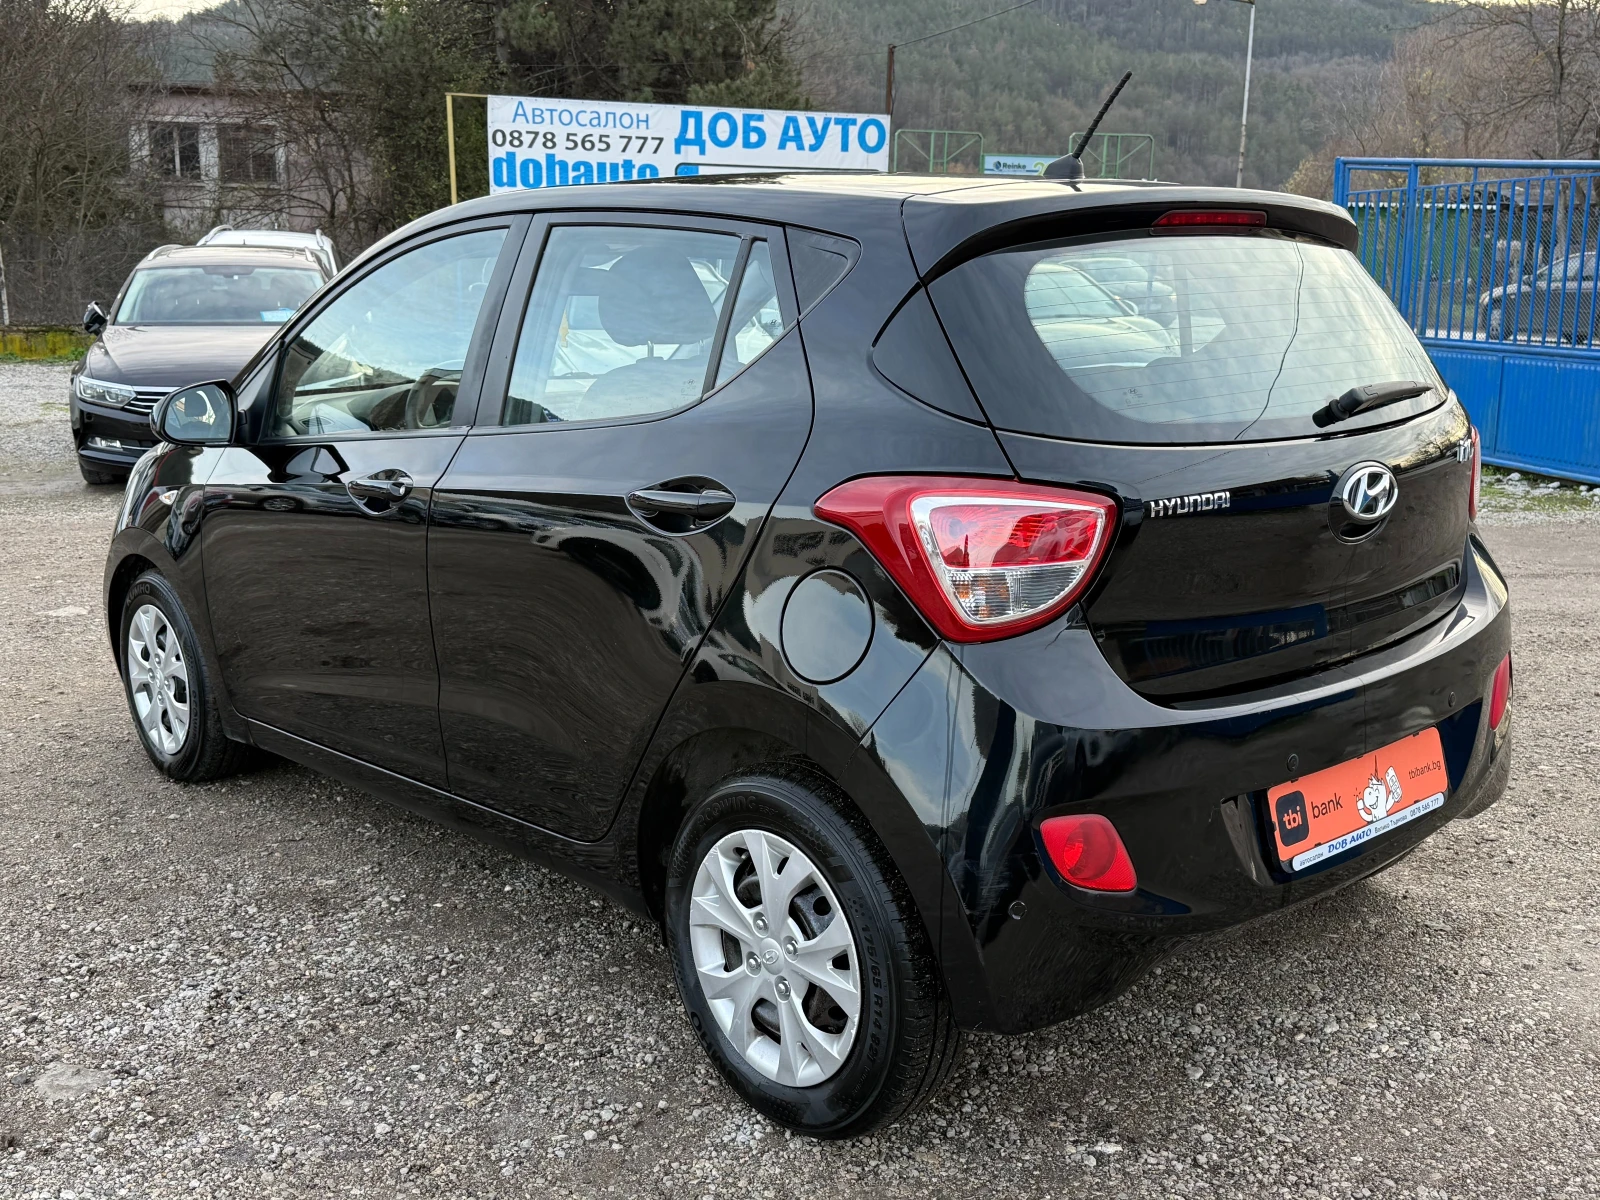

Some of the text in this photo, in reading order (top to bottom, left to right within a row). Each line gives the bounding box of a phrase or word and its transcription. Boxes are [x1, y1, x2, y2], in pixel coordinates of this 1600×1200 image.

[512, 100, 649, 130] Автосалон
[491, 129, 664, 155] 0878 565 777
[674, 109, 886, 156] ДОБ АУТО
[1002, 162, 1027, 170] Reinke
[1150, 491, 1231, 518] HYUNDAI
[1408, 760, 1442, 780] tbibank.bg
[1283, 792, 1344, 830] tbi bank
[1327, 838, 1348, 854] DOB
[861, 923, 883, 989] 175/65
